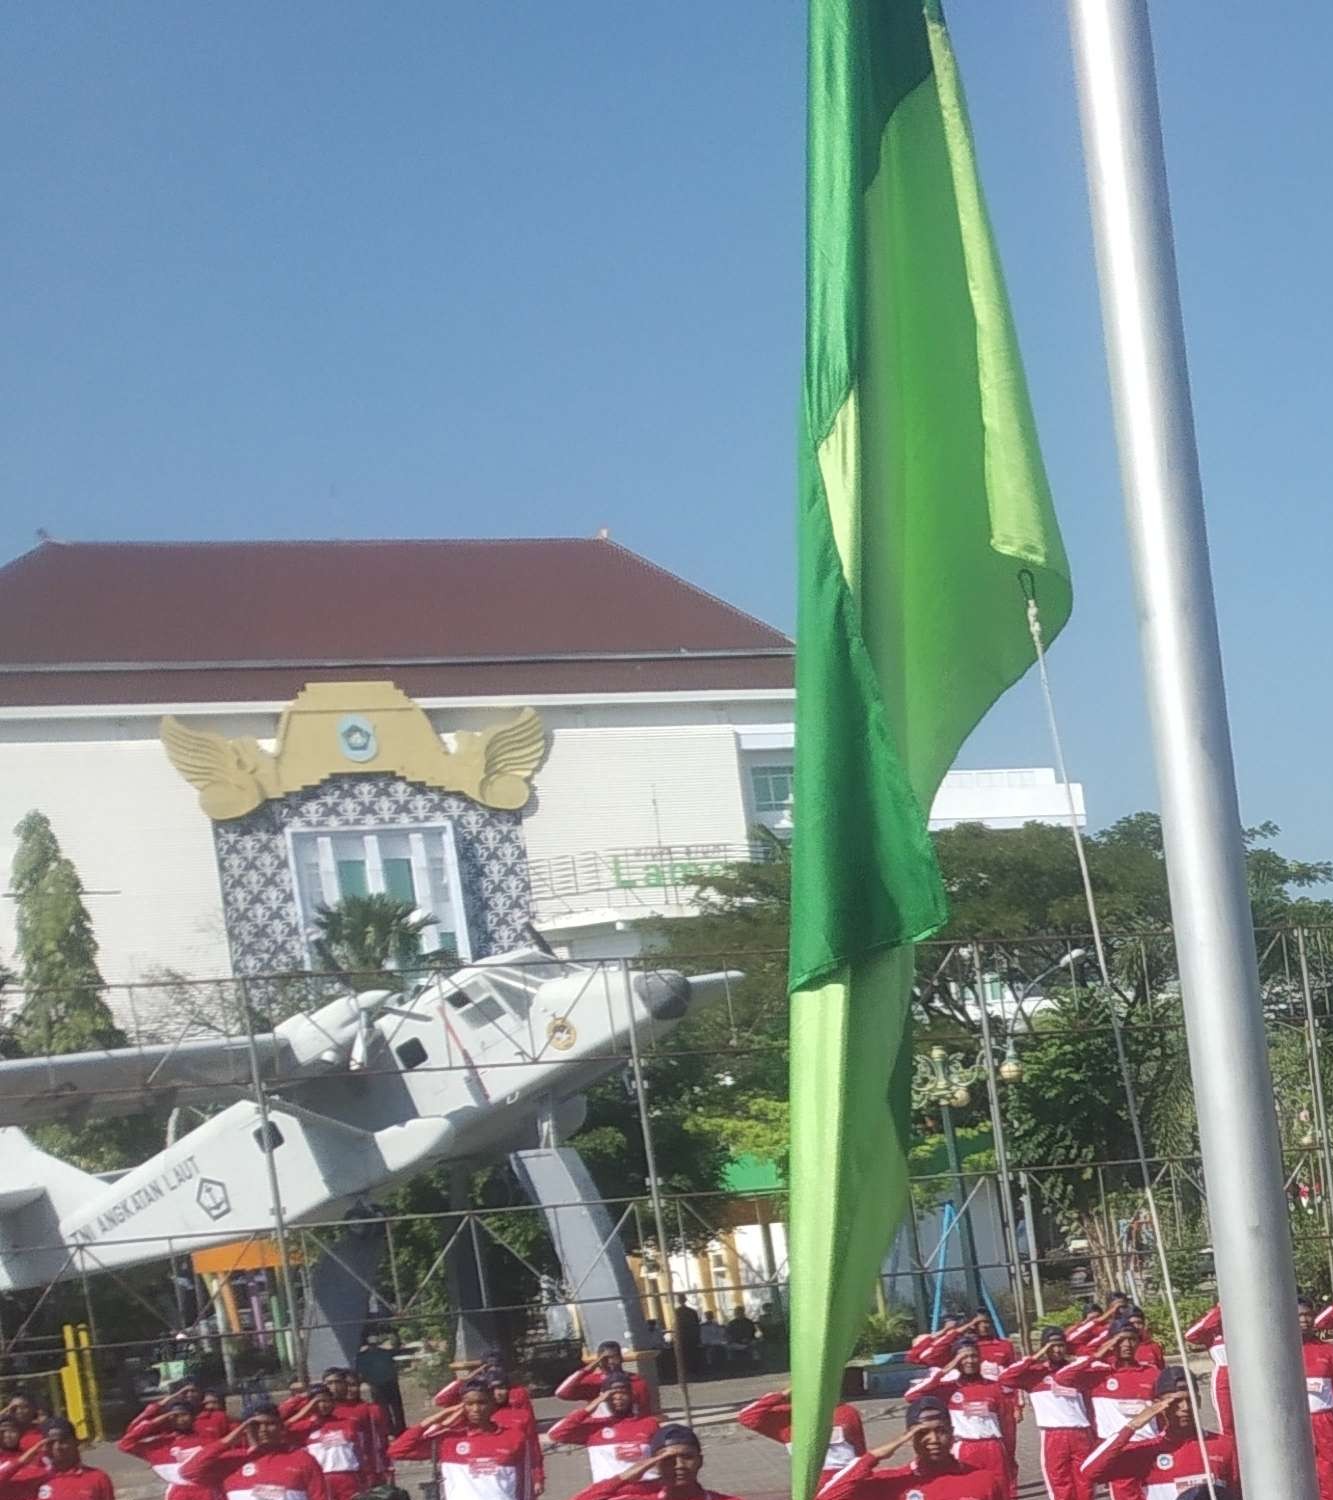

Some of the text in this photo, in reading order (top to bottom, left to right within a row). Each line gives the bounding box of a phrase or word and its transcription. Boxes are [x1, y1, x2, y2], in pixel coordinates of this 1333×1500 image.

[69, 1155, 201, 1245] TNI ANGKATAN LAUT
